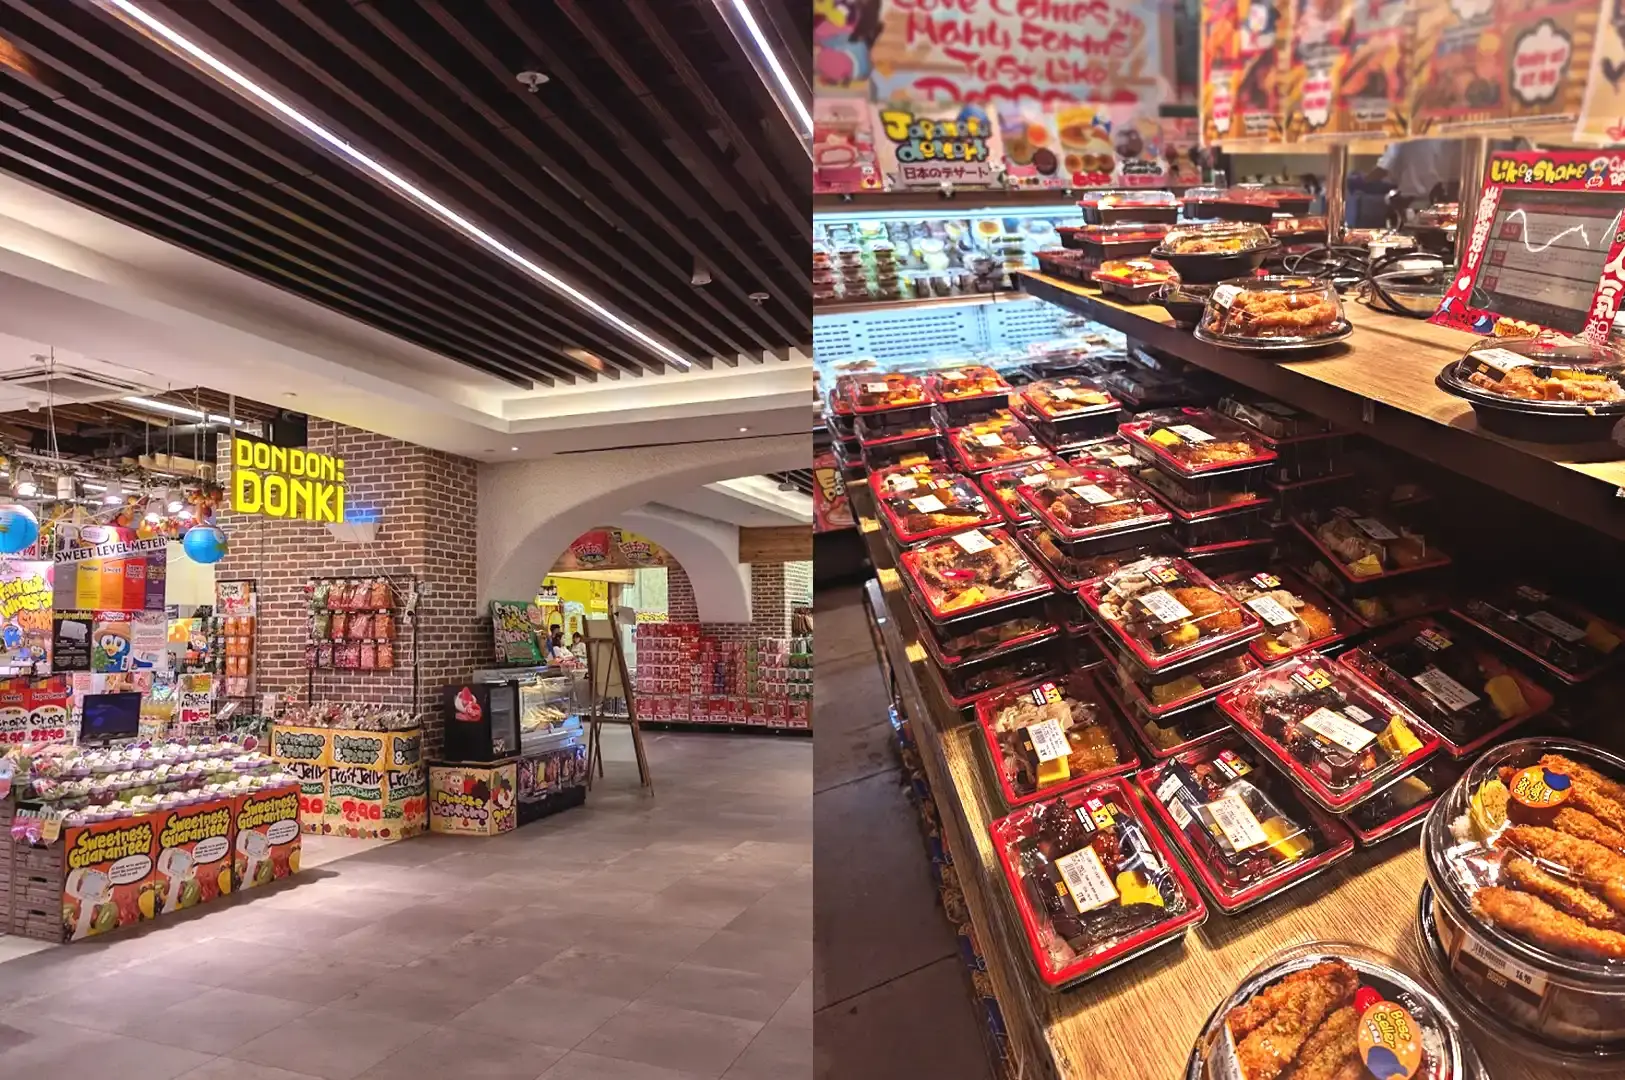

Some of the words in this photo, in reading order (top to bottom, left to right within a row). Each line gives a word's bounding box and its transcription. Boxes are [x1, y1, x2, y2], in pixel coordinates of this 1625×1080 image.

[1490, 159, 1528, 183] Like
[1532, 159, 1588, 184] Share
[236, 438, 287, 473] DON
[290, 448, 335, 481] DON
[236, 471, 344, 523] DONKI
[54, 547, 94, 564] SWEET
[97, 543, 128, 557] LEVEL
[131, 537, 166, 550] METER
[0, 716, 27, 727] rape
[30, 713, 64, 725] Grape
[298, 762, 327, 779] Jelly
[328, 766, 356, 784] Fruit
[356, 767, 384, 785] Jelly
[1513, 776, 1531, 796] Best
[238, 802, 298, 829] Guaranteed
[244, 794, 297, 815] Sweetness
[160, 818, 230, 848] Guaranteed
[167, 809, 230, 834] Sweetness
[69, 834, 152, 868] Guaranteed
[77, 824, 151, 854] Sweetness
[1373, 1012, 1396, 1049] Seller
[1390, 1009, 1412, 1041] Best
